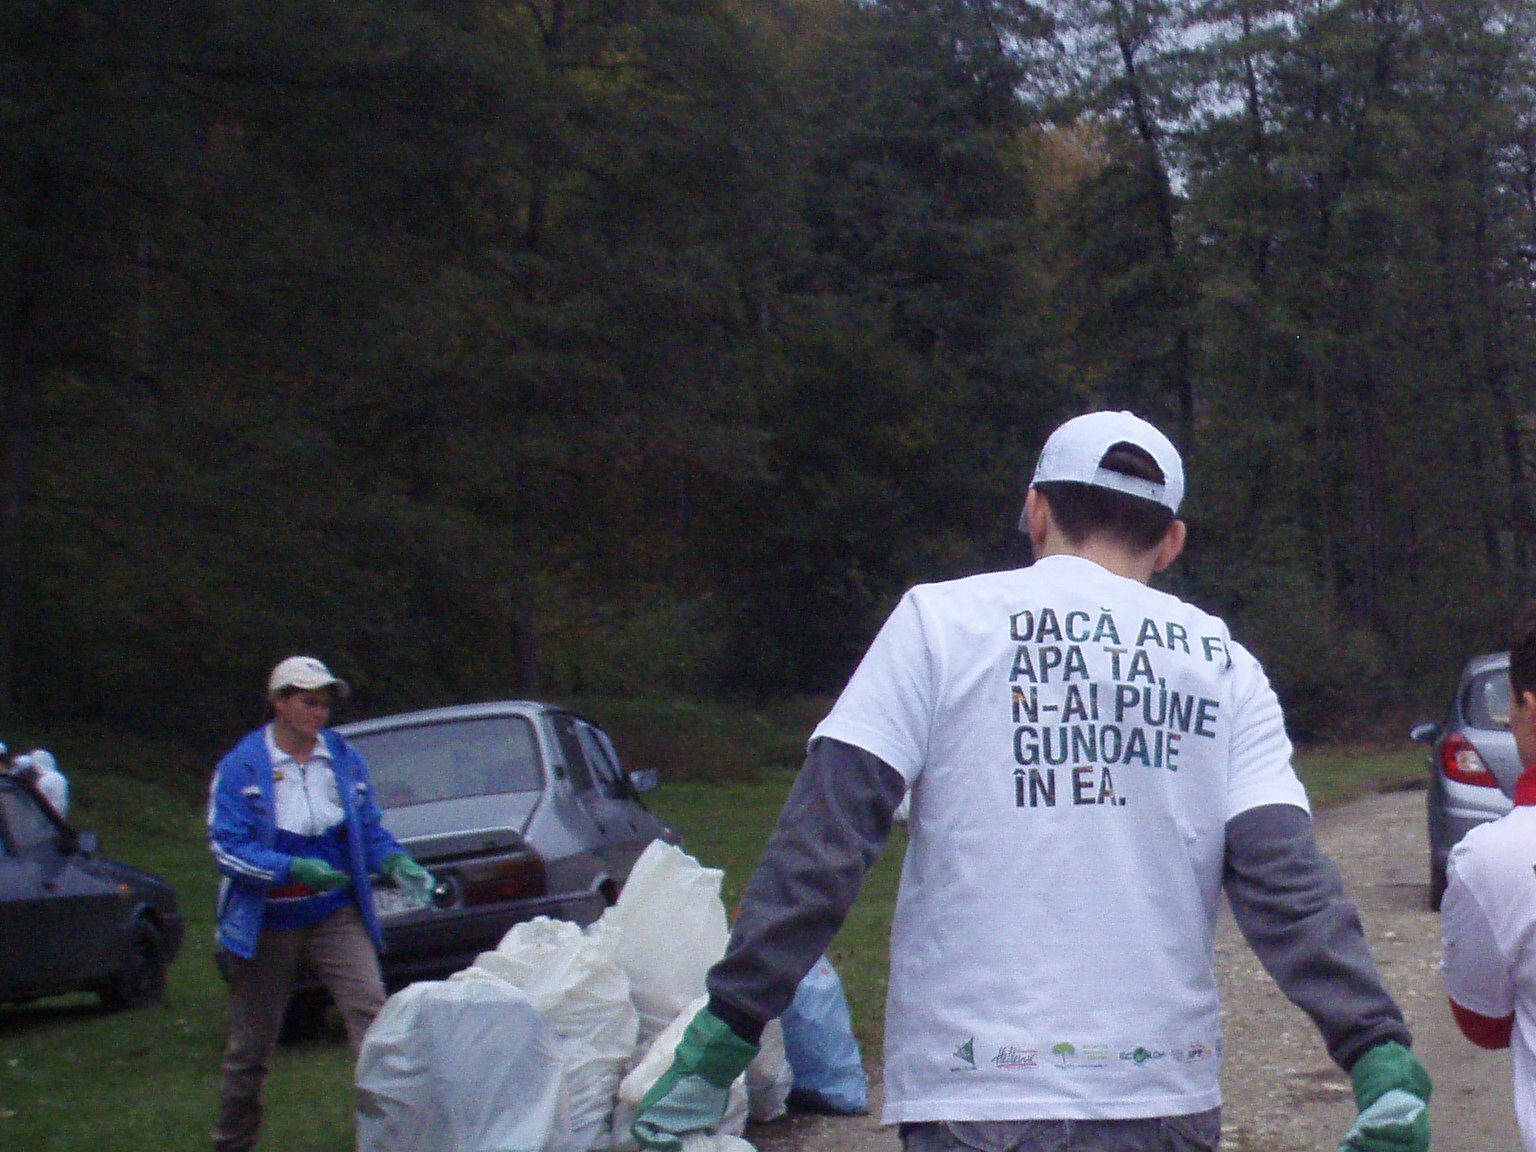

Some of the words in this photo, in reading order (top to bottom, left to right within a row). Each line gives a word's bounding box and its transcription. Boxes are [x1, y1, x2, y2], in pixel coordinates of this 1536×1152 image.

[1009, 606, 1122, 645] DACĂ
[1136, 617, 1190, 655] AR
[1008, 645, 1090, 683] APA
[1103, 646, 1166, 688] TA,
[1010, 682, 1099, 723] N-AI
[1115, 684, 1220, 739] PUNE
[1013, 724, 1182, 772] GUNOAIE
[1012, 768, 1056, 807] ÎN
[1072, 765, 1126, 807] EA.
